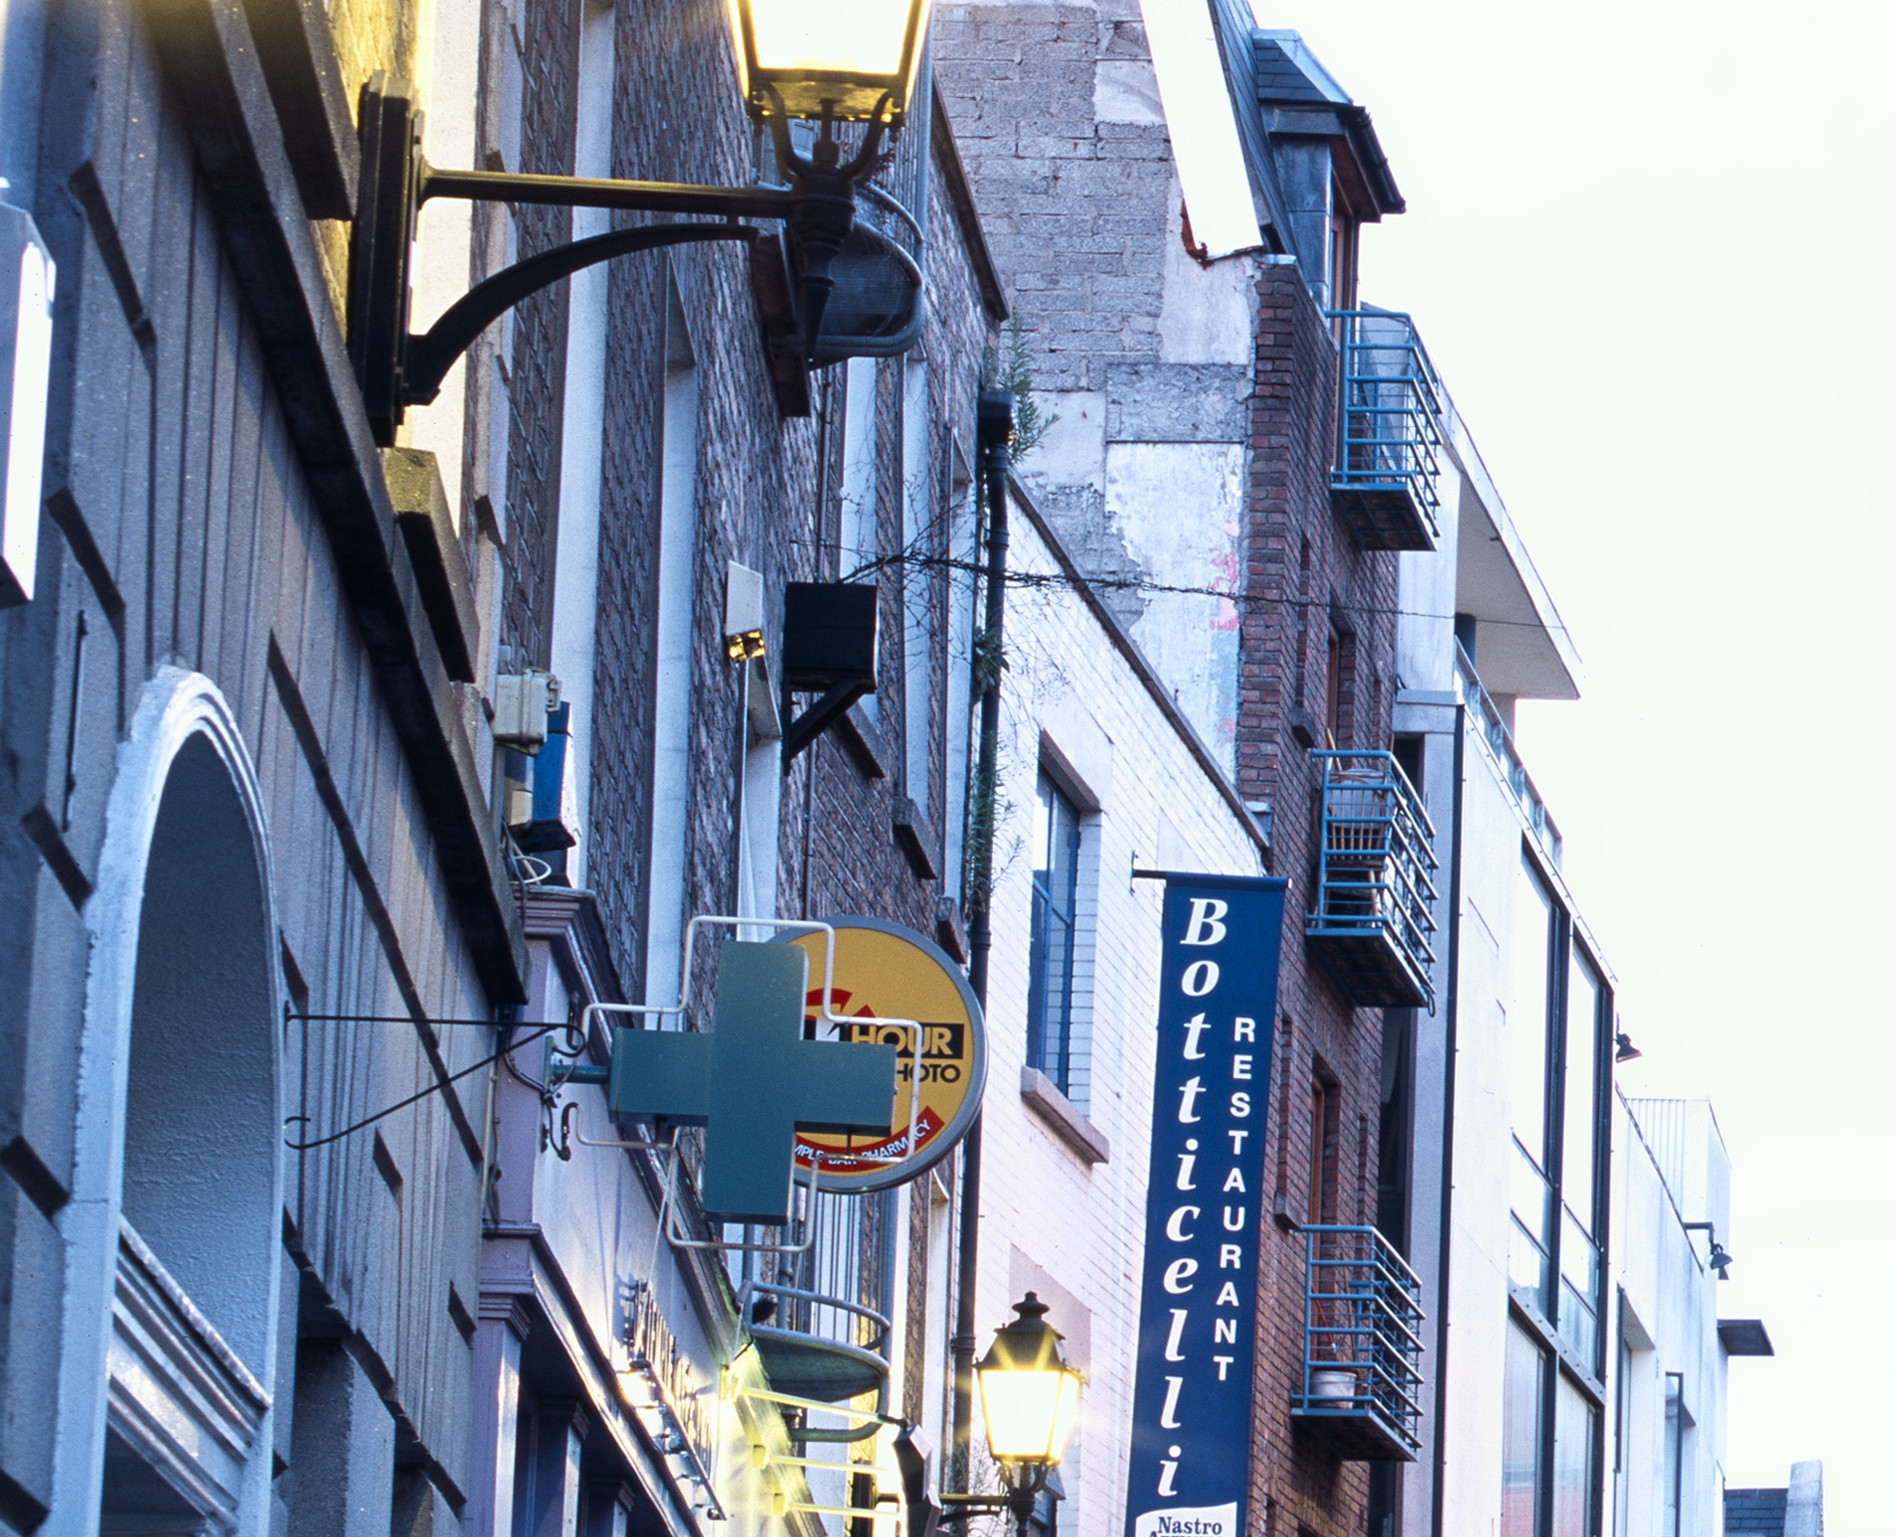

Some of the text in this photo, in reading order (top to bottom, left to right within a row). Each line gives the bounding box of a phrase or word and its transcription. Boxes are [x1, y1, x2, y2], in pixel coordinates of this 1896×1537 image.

[852, 1025, 953, 1055] HOUR
[897, 1064, 961, 1083] HOTO
[1157, 896, 1228, 1497] Botticelli
[1213, 1016, 1257, 1382] RESTAURANT
[1157, 1515, 1223, 1536] Nastro
